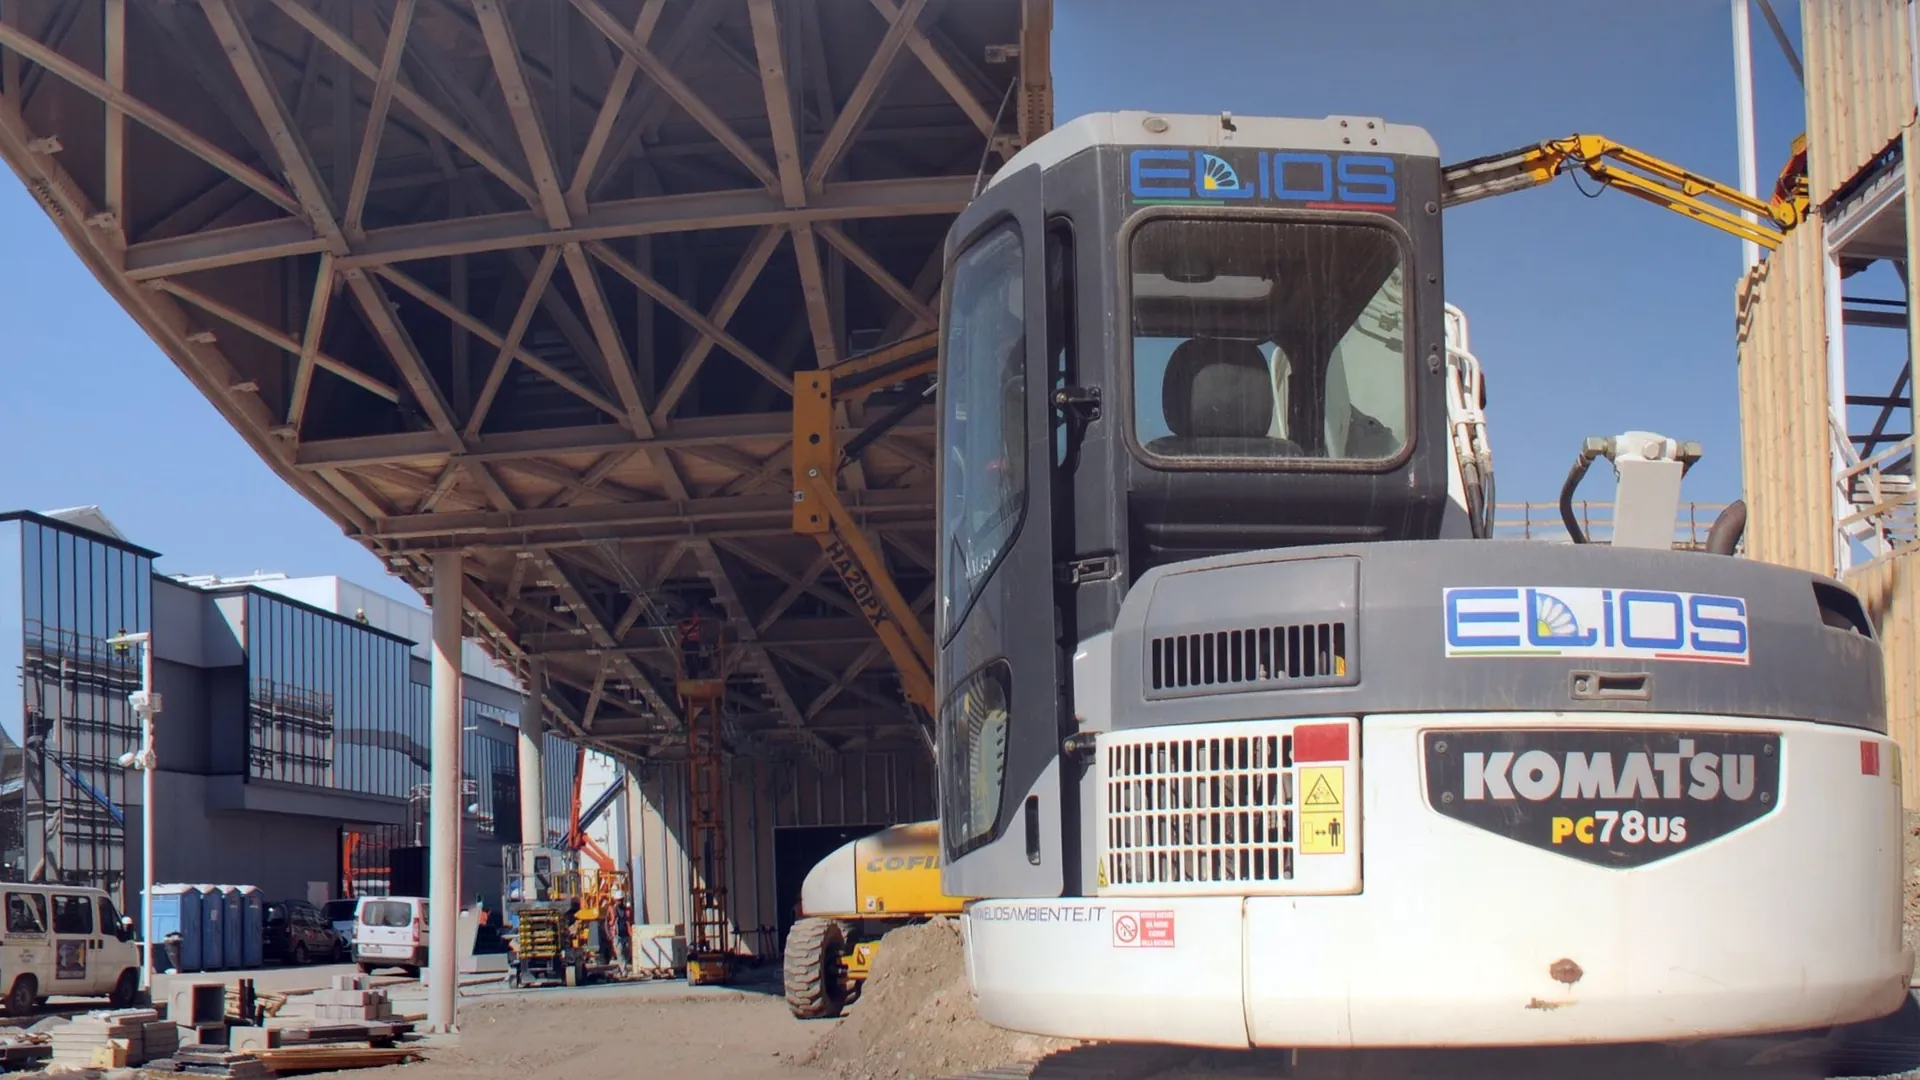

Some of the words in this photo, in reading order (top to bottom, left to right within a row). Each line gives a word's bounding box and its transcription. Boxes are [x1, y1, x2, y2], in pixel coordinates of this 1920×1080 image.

[825, 541, 890, 628] HA20PX
[1463, 739, 1755, 800] KOMATSU
[1552, 810, 1687, 844] PC78US
